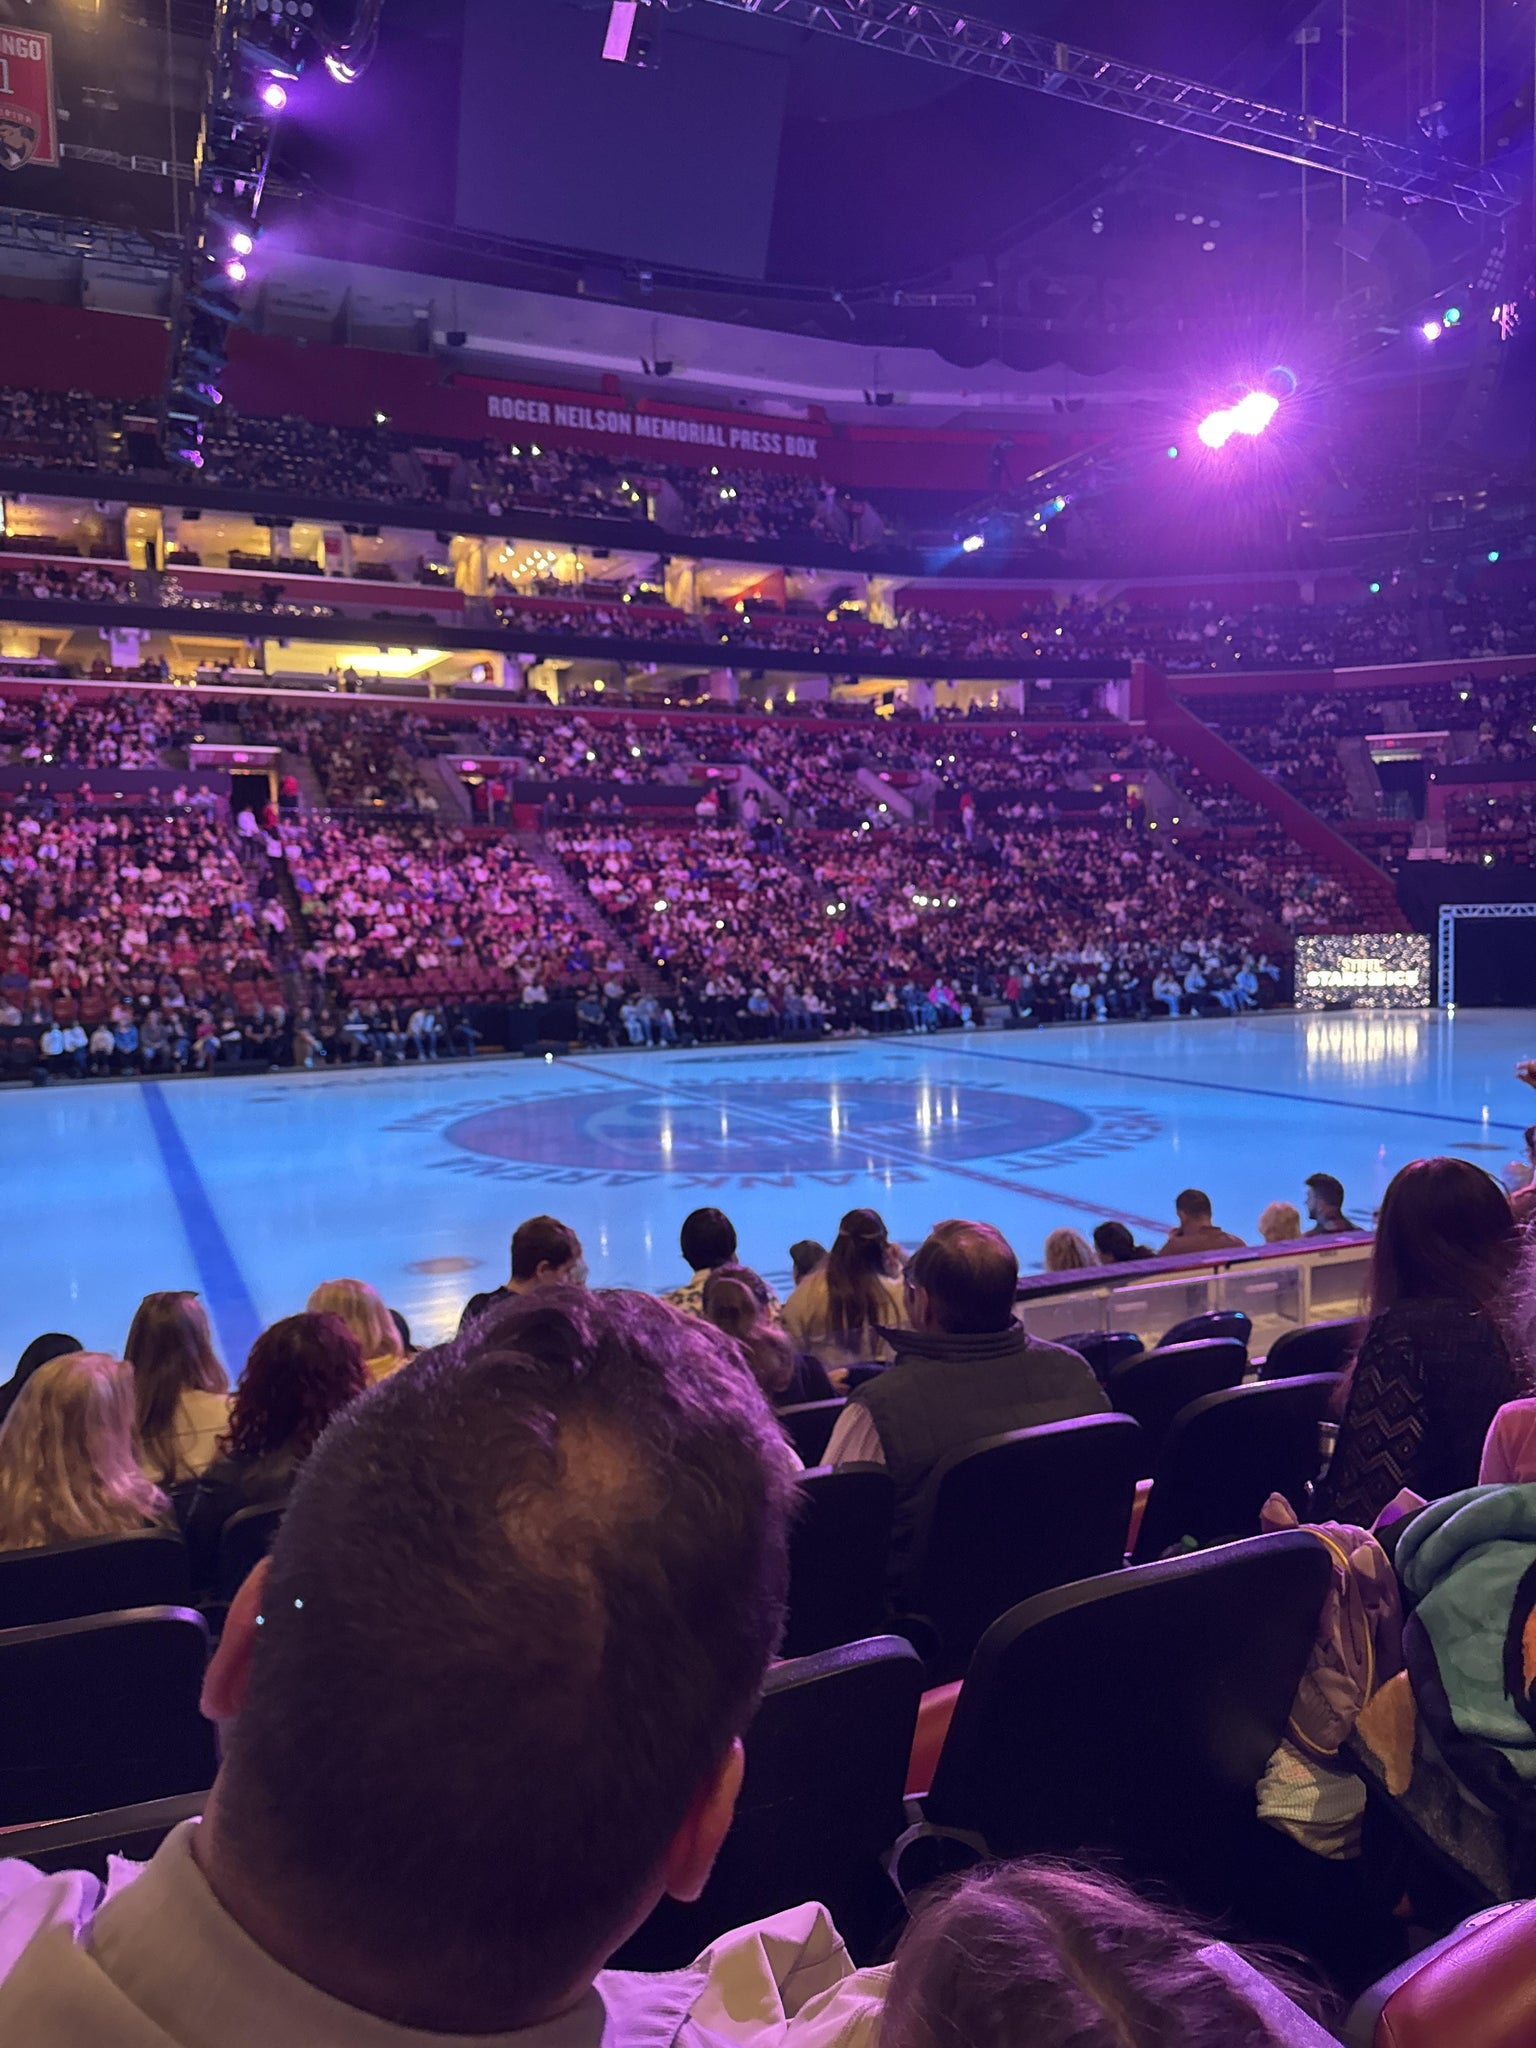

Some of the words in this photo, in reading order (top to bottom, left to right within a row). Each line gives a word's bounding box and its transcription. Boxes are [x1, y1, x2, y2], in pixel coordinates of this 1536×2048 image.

[488, 396, 551, 423] ROGER
[555, 404, 632, 435] NEILSON
[635, 415, 727, 447] MEMORIAL
[729, 427, 783, 454] PRESS
[785, 435, 818, 459] BOX
[1306, 971, 1367, 987] STARS
